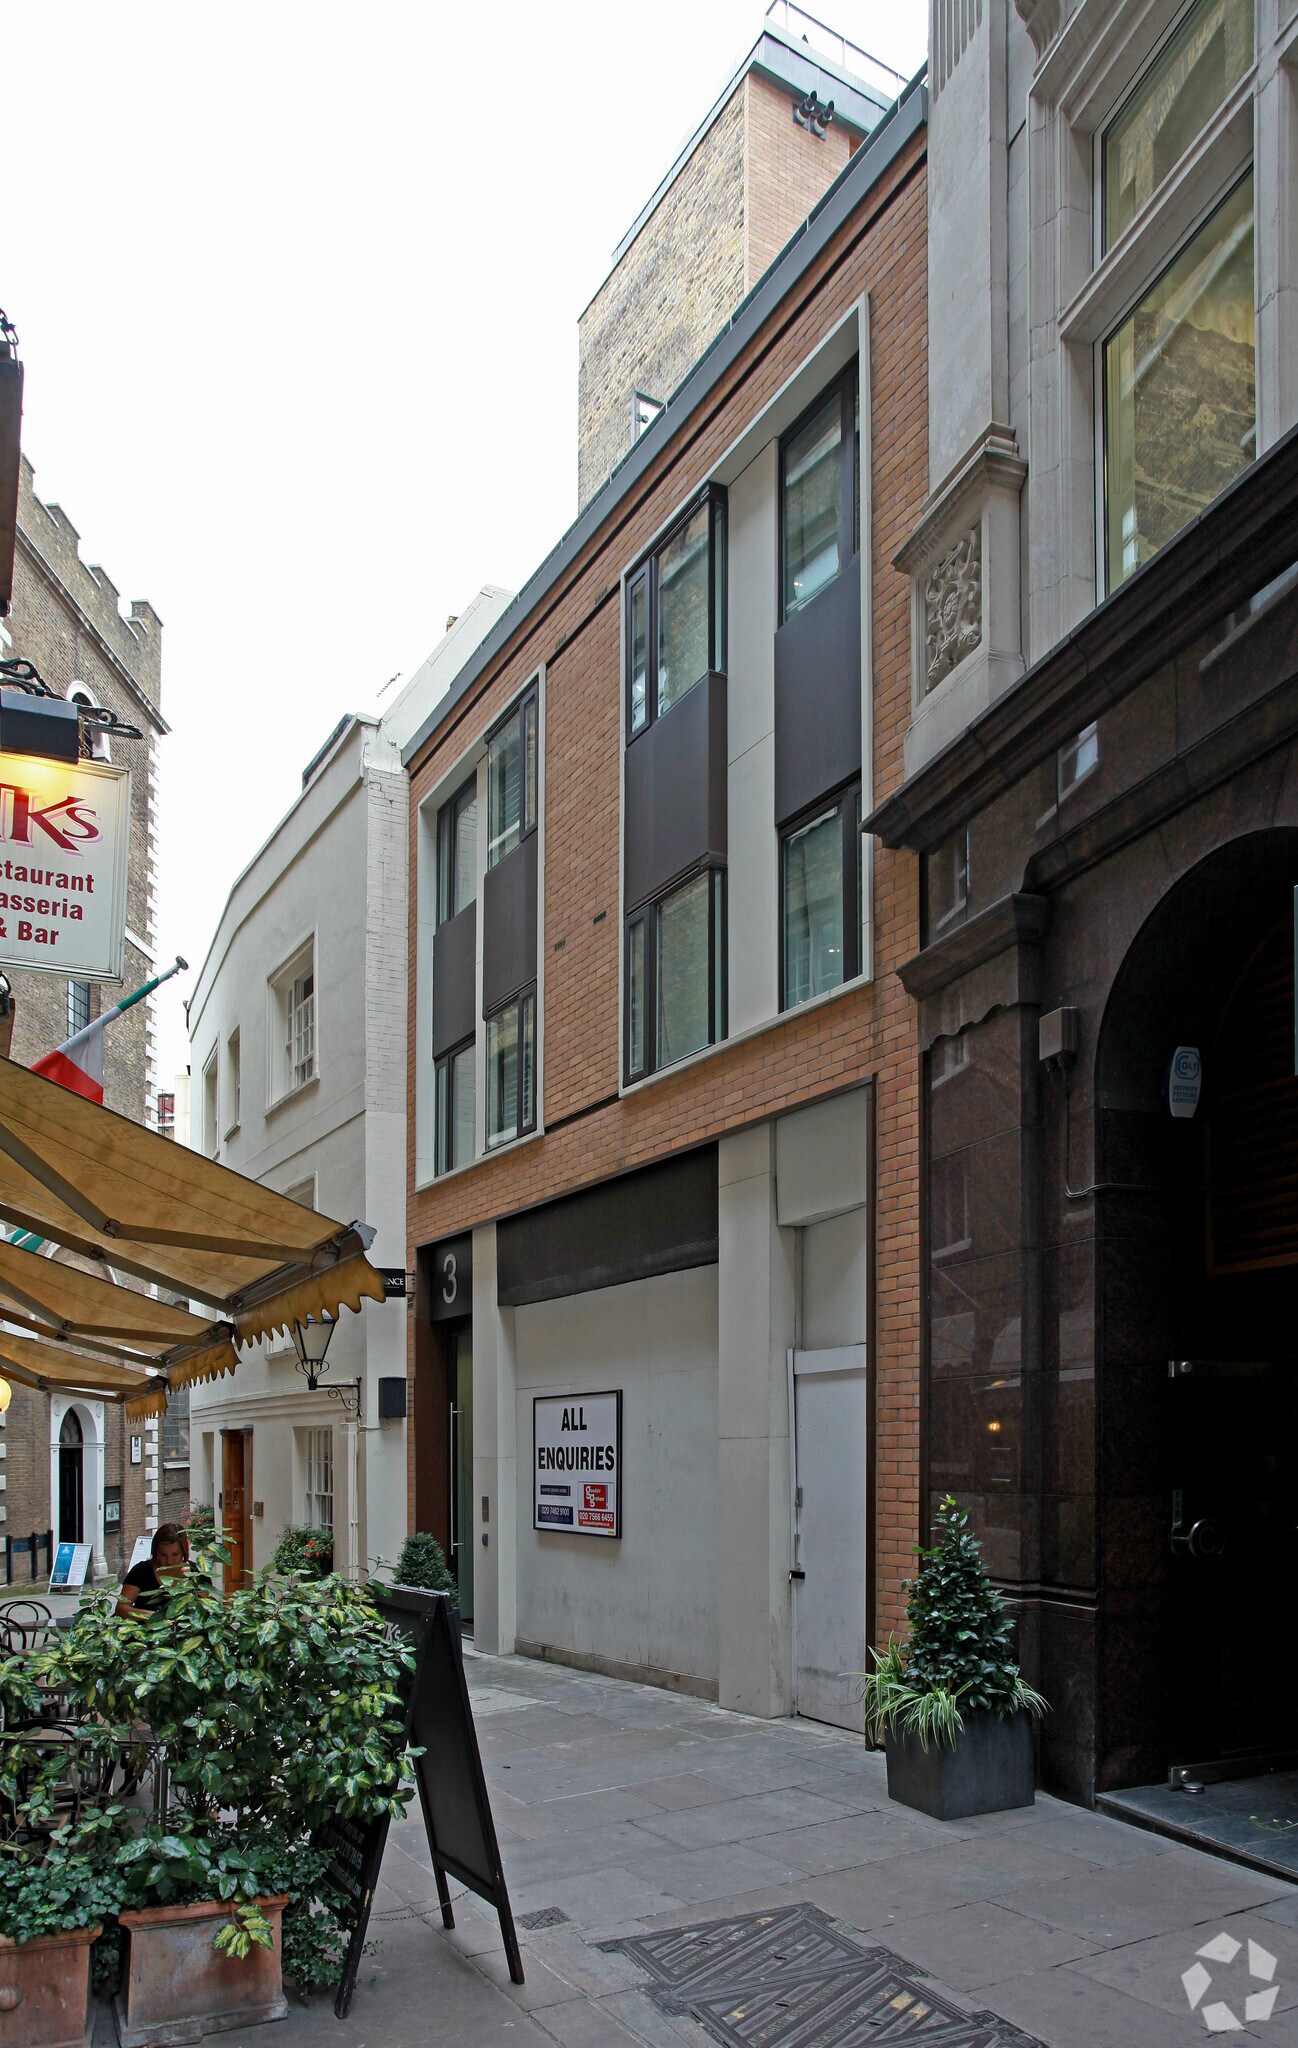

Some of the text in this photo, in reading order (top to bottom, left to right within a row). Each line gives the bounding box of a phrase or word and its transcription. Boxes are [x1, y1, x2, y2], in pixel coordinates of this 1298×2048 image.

[18, 920, 60, 945] Bar
[442, 1253, 458, 1304] 3
[561, 1407, 587, 1431] ALL
[538, 1445, 615, 1472] ENQUIRIES
[541, 1506, 549, 1515] 020
[579, 1511, 588, 1520] 020
